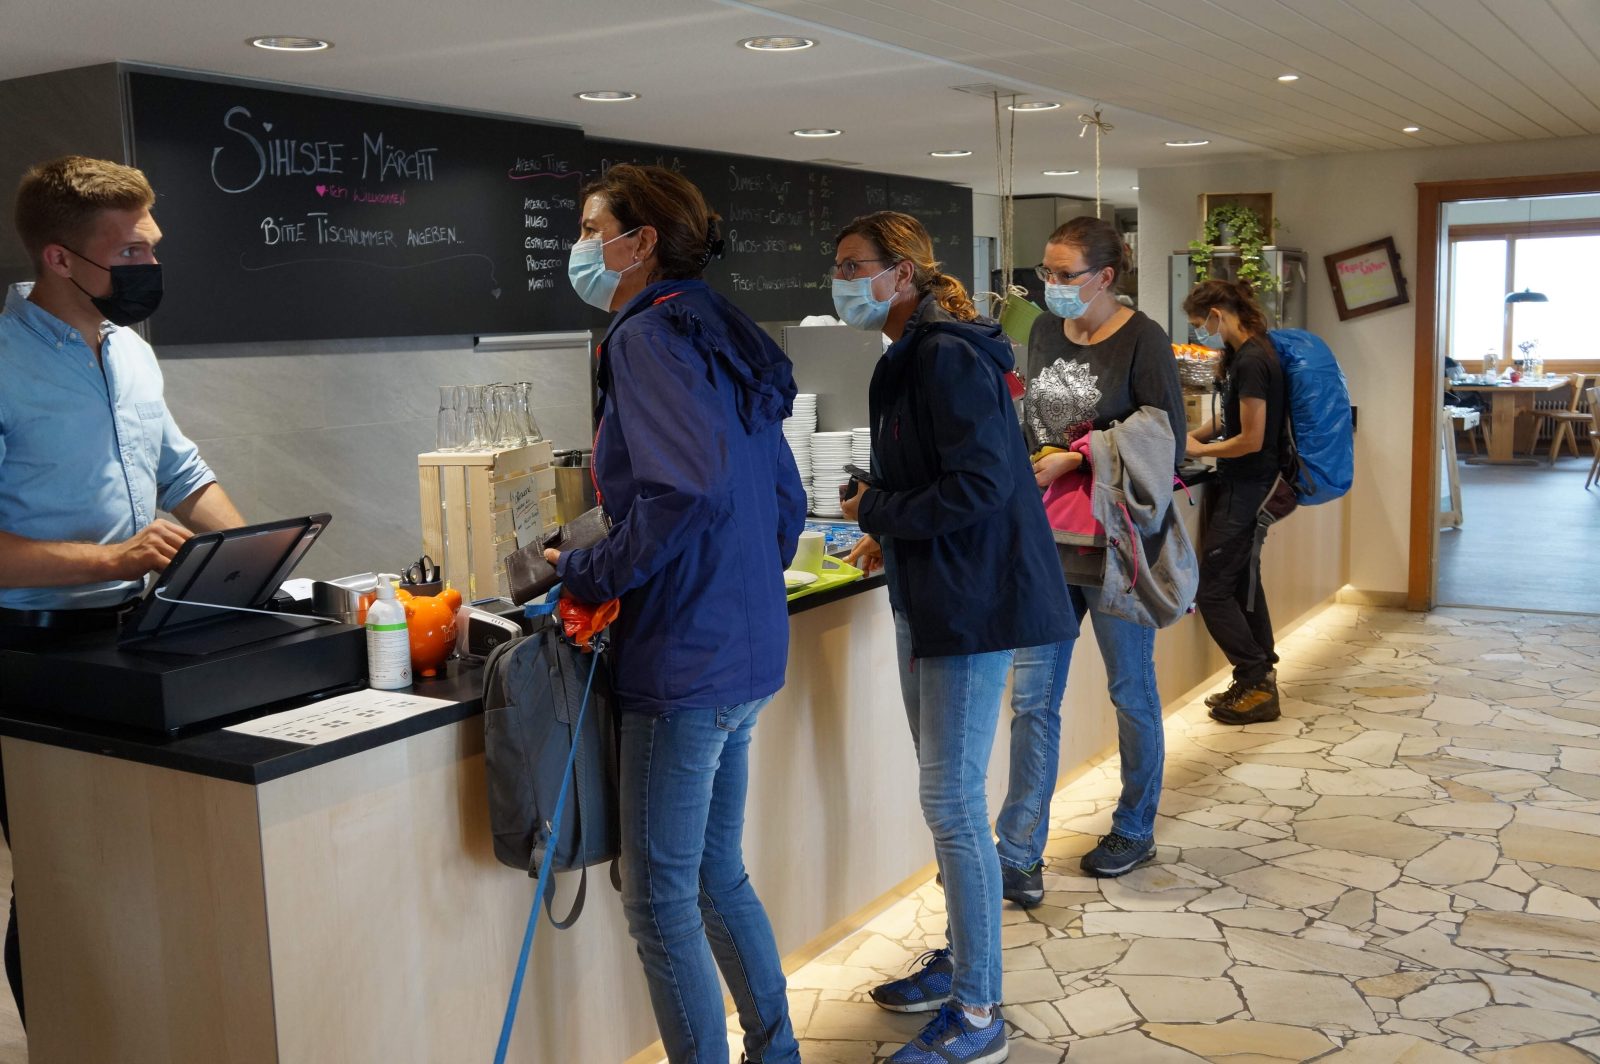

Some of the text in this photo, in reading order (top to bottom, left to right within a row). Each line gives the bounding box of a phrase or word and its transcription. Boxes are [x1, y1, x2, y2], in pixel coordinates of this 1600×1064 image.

[523, 197, 551, 210] APEROL
[261, 216, 306, 245] BITTE
[307, 212, 398, 248] TISCHNUMMER
[525, 214, 548, 229] HUGO
[526, 254, 562, 272] PROSECCO
[528, 273, 554, 291] MARTINI
